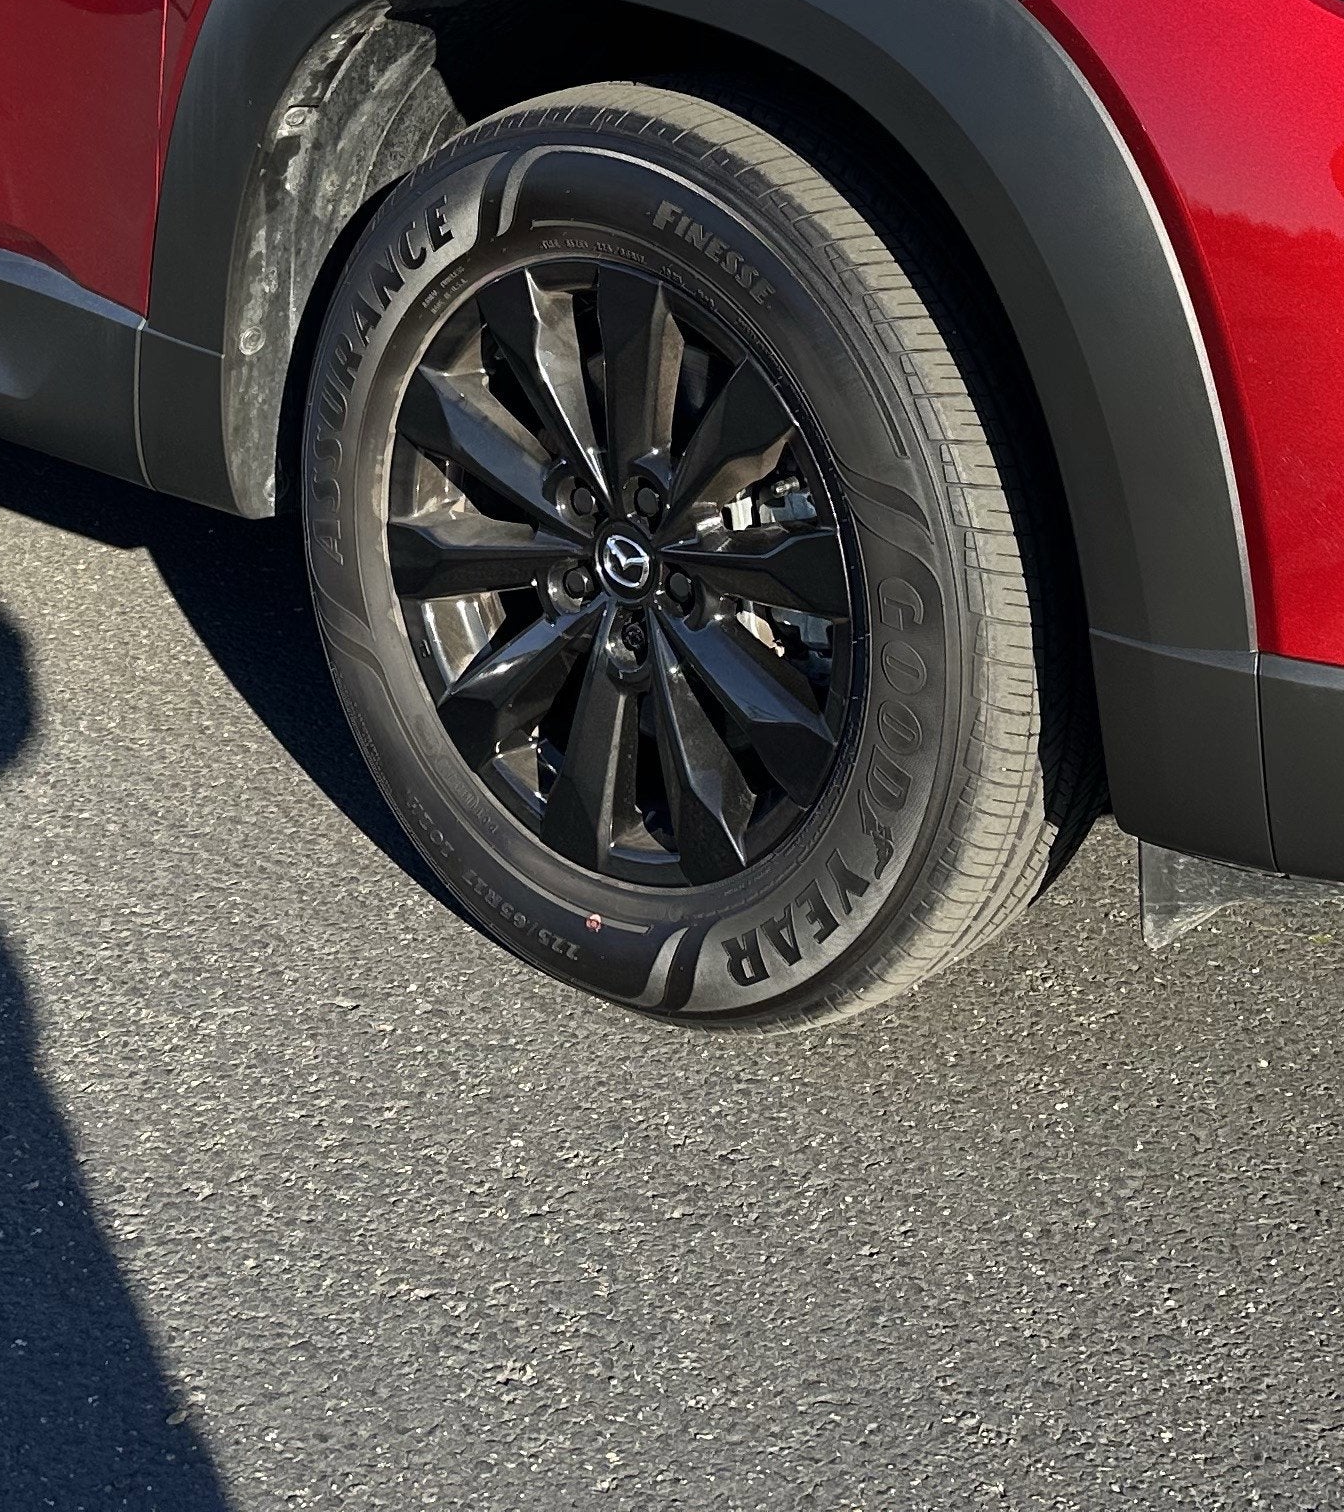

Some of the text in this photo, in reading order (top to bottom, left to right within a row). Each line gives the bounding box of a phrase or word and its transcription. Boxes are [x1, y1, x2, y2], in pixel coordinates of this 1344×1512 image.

[311, 194, 456, 568] ASSURANCE
[652, 199, 776, 305] FINESSE
[720, 575, 927, 988] GOODYEAR
